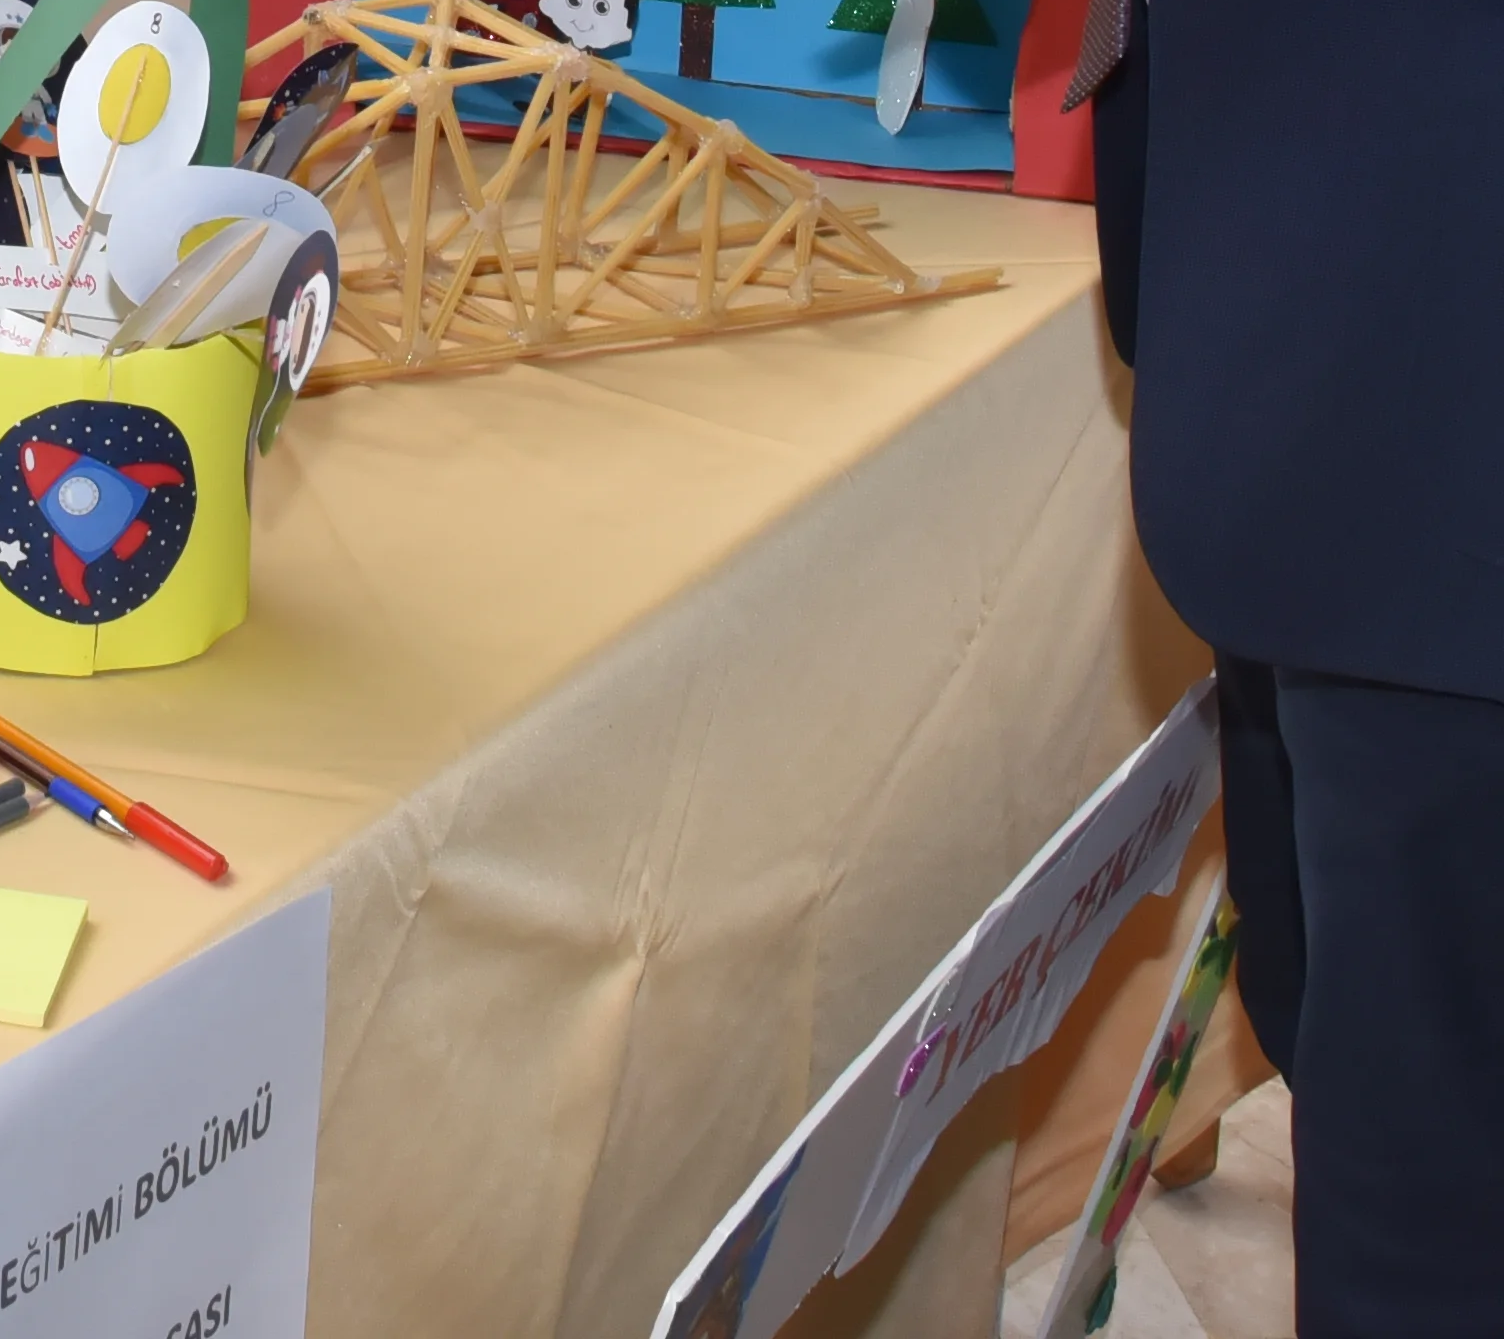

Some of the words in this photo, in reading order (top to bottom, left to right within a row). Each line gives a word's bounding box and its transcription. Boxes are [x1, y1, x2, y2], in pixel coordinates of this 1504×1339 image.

[149, 12, 163, 35] 8
[925, 934, 1042, 1107] YER
[0, 1183, 124, 1311] EĞİTİMİ
[133, 1080, 273, 1220] BÖLÜMÜ
